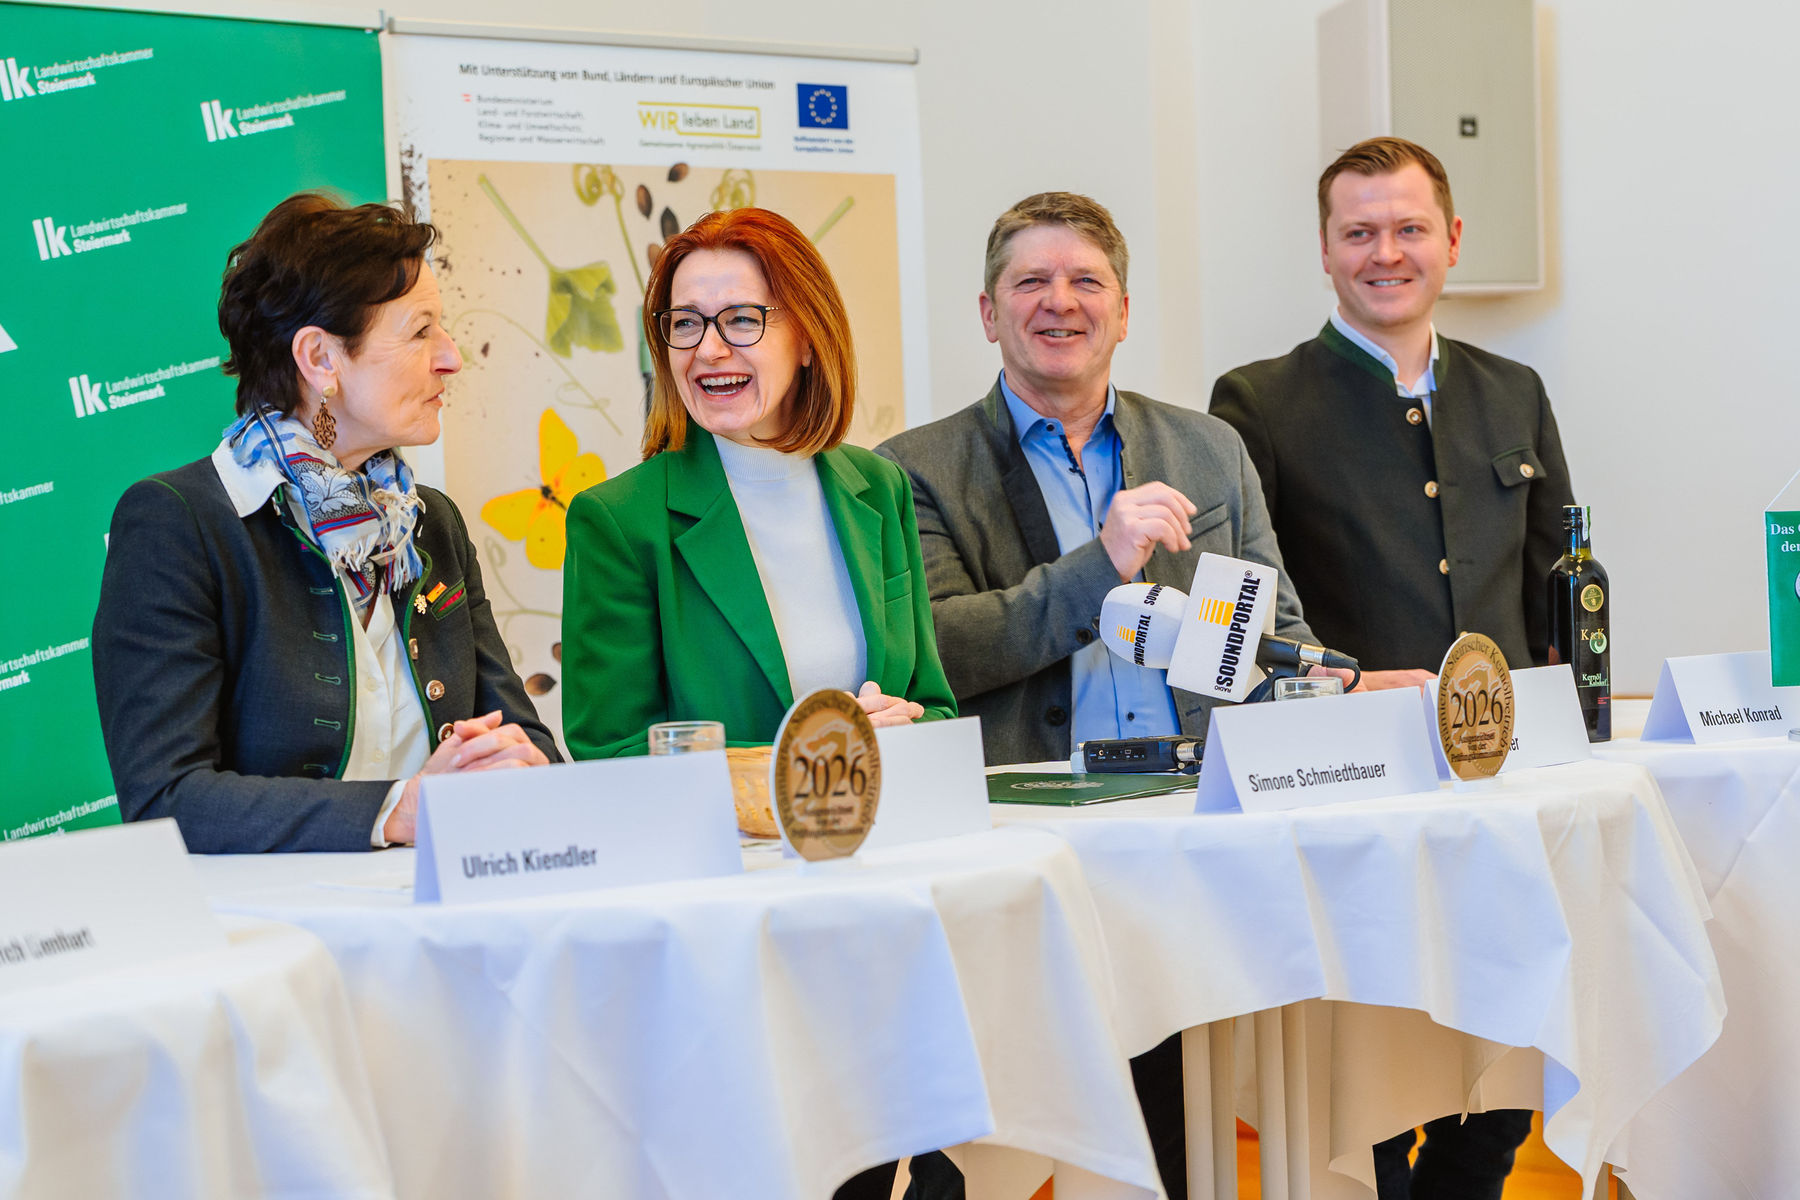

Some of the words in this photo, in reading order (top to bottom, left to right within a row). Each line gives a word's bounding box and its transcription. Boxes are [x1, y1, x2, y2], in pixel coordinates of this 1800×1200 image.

[33, 48, 153, 79] Landwirtschaftskammer
[459, 64, 478, 75] Mit
[481, 65, 556, 81] Unterstützung
[560, 71, 578, 80] von
[614, 72, 654, 84] Ländern
[658, 75, 677, 85] und
[747, 80, 776, 90] Union
[37, 72, 96, 95] Steiermark
[200, 100, 238, 142] lk
[236, 90, 346, 121] Landwirtschaftskammer
[638, 109, 679, 131] WIR
[682, 112, 719, 128] leben
[723, 115, 755, 130] Land
[239, 114, 295, 136] Steiermark
[70, 203, 187, 238] Landwirtschaftskammer
[33, 217, 72, 261] lk
[73, 229, 131, 253] Steiermark
[105, 356, 221, 394] Landwirtschaftskammer
[68, 374, 107, 418] lk
[108, 384, 165, 410] Steiermark
[1770, 523, 1795, 535] Das
[1581, 629, 1590, 640] K
[1451, 687, 1503, 729] 2026
[1699, 707, 1744, 727] Michael
[1743, 704, 1783, 723] Konrad
[794, 753, 867, 798] 2026
[1248, 773, 1296, 793] Simone
[1296, 762, 1386, 787] Schmiedtbauer
[462, 851, 518, 878] Ulrich
[522, 844, 598, 872] Kiendler
